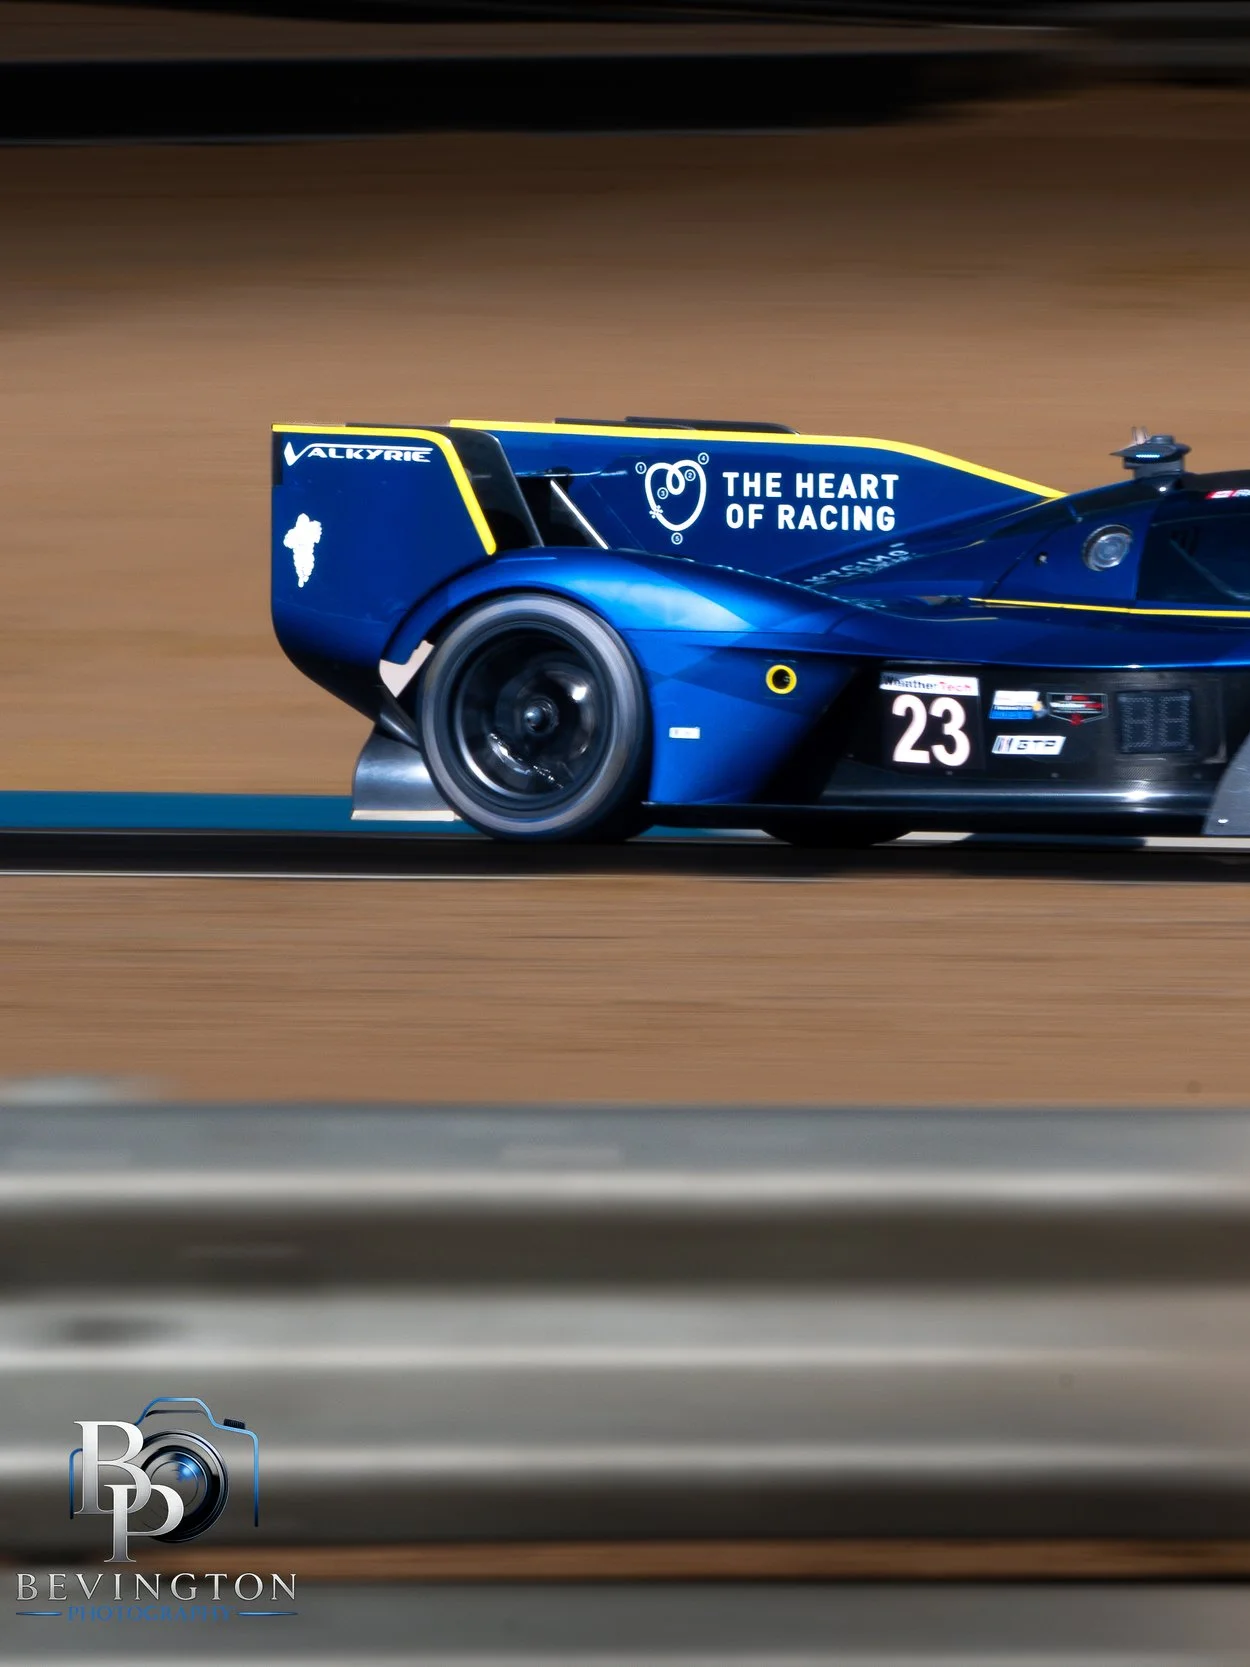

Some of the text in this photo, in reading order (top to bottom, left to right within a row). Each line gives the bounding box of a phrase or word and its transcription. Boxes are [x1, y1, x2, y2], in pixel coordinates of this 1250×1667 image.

[283, 441, 434, 467] VALKYRIE
[722, 471, 900, 500] THE HEART
[725, 503, 896, 532] OF RACING
[891, 693, 971, 767] 23
